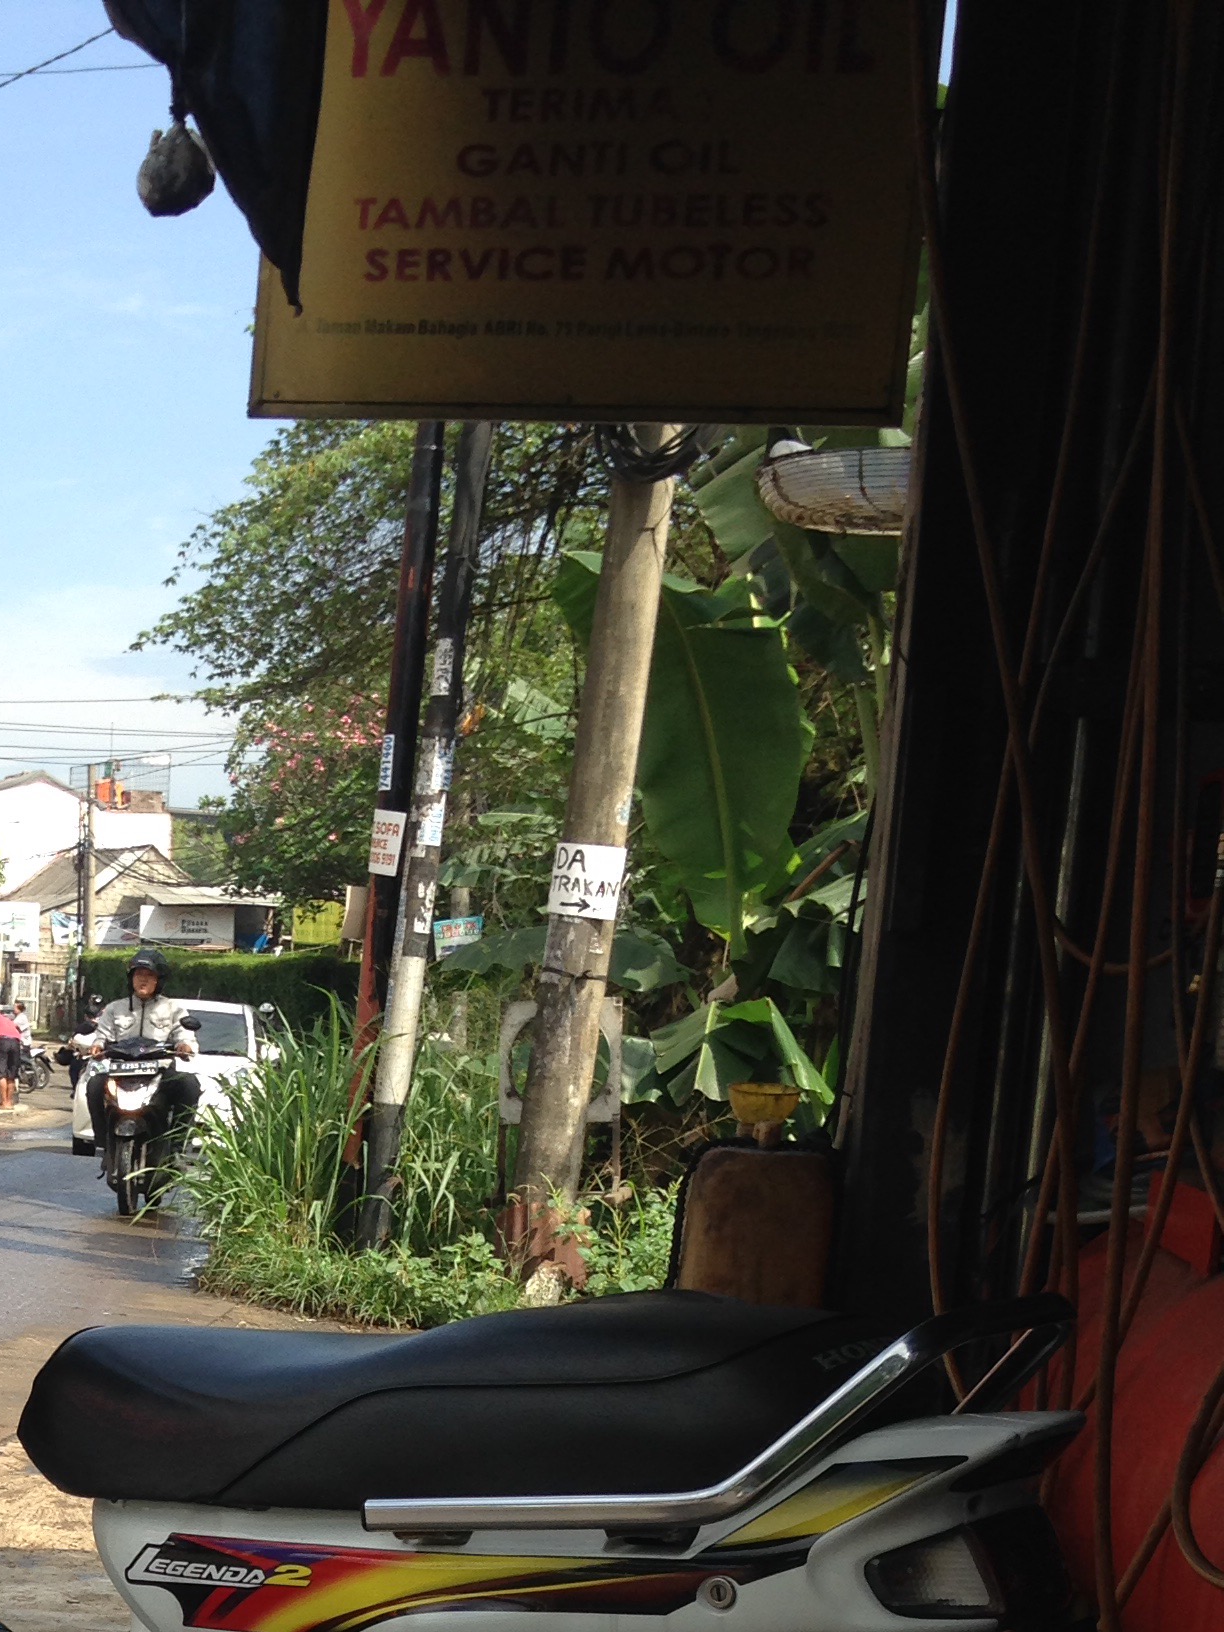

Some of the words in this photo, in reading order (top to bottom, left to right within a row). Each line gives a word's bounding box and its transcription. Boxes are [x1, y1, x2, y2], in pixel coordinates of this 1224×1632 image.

[456, 142, 627, 178] GANTI
[648, 139, 742, 175] OIL
[354, 196, 579, 231] TAMBAL
[587, 192, 828, 230] TUBELESS
[363, 245, 585, 283] SERVICE
[605, 246, 814, 281] MOTOR
[418, 318, 478, 340] Bahagia
[557, 846, 586, 873] DA
[552, 874, 620, 898] TRAKAN
